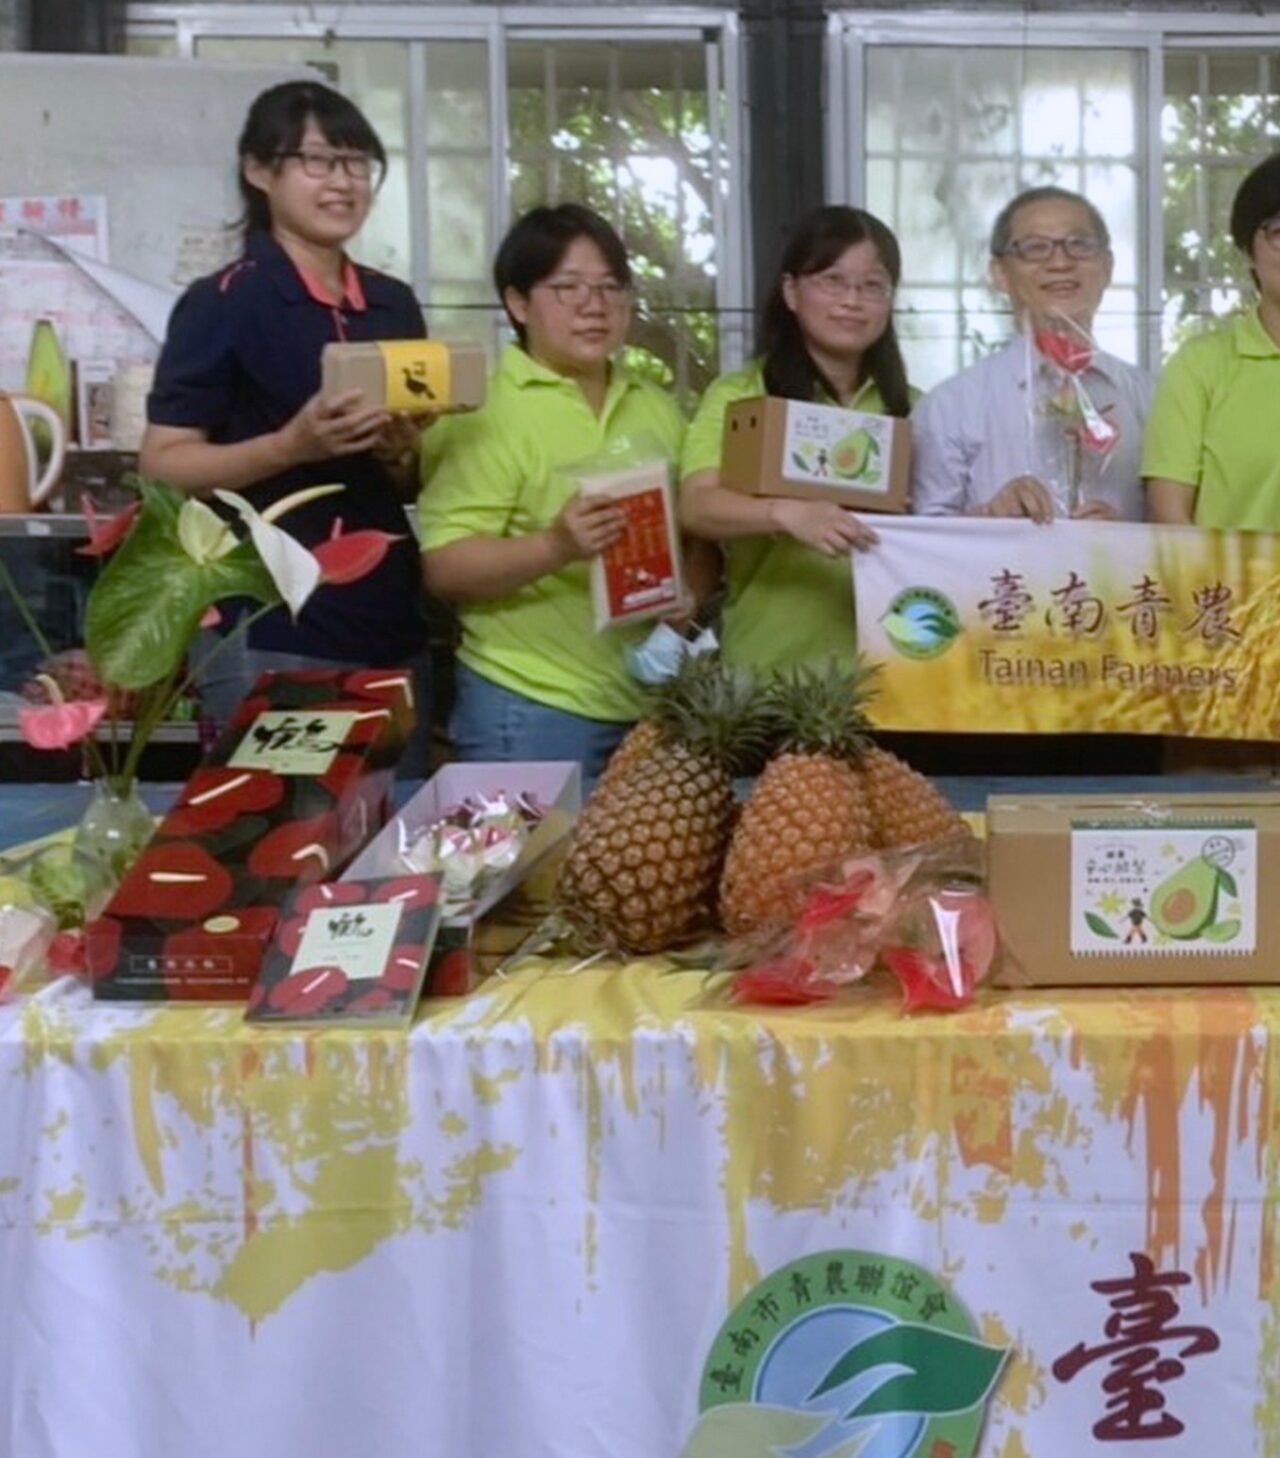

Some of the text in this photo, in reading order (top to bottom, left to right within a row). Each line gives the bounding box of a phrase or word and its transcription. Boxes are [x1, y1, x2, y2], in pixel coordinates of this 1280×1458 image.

[978, 568, 1242, 641] 臺南青農
[979, 648, 1239, 693] Tainan Farmers
[708, 1260, 949, 1395] 臺南市青農聯誼會
